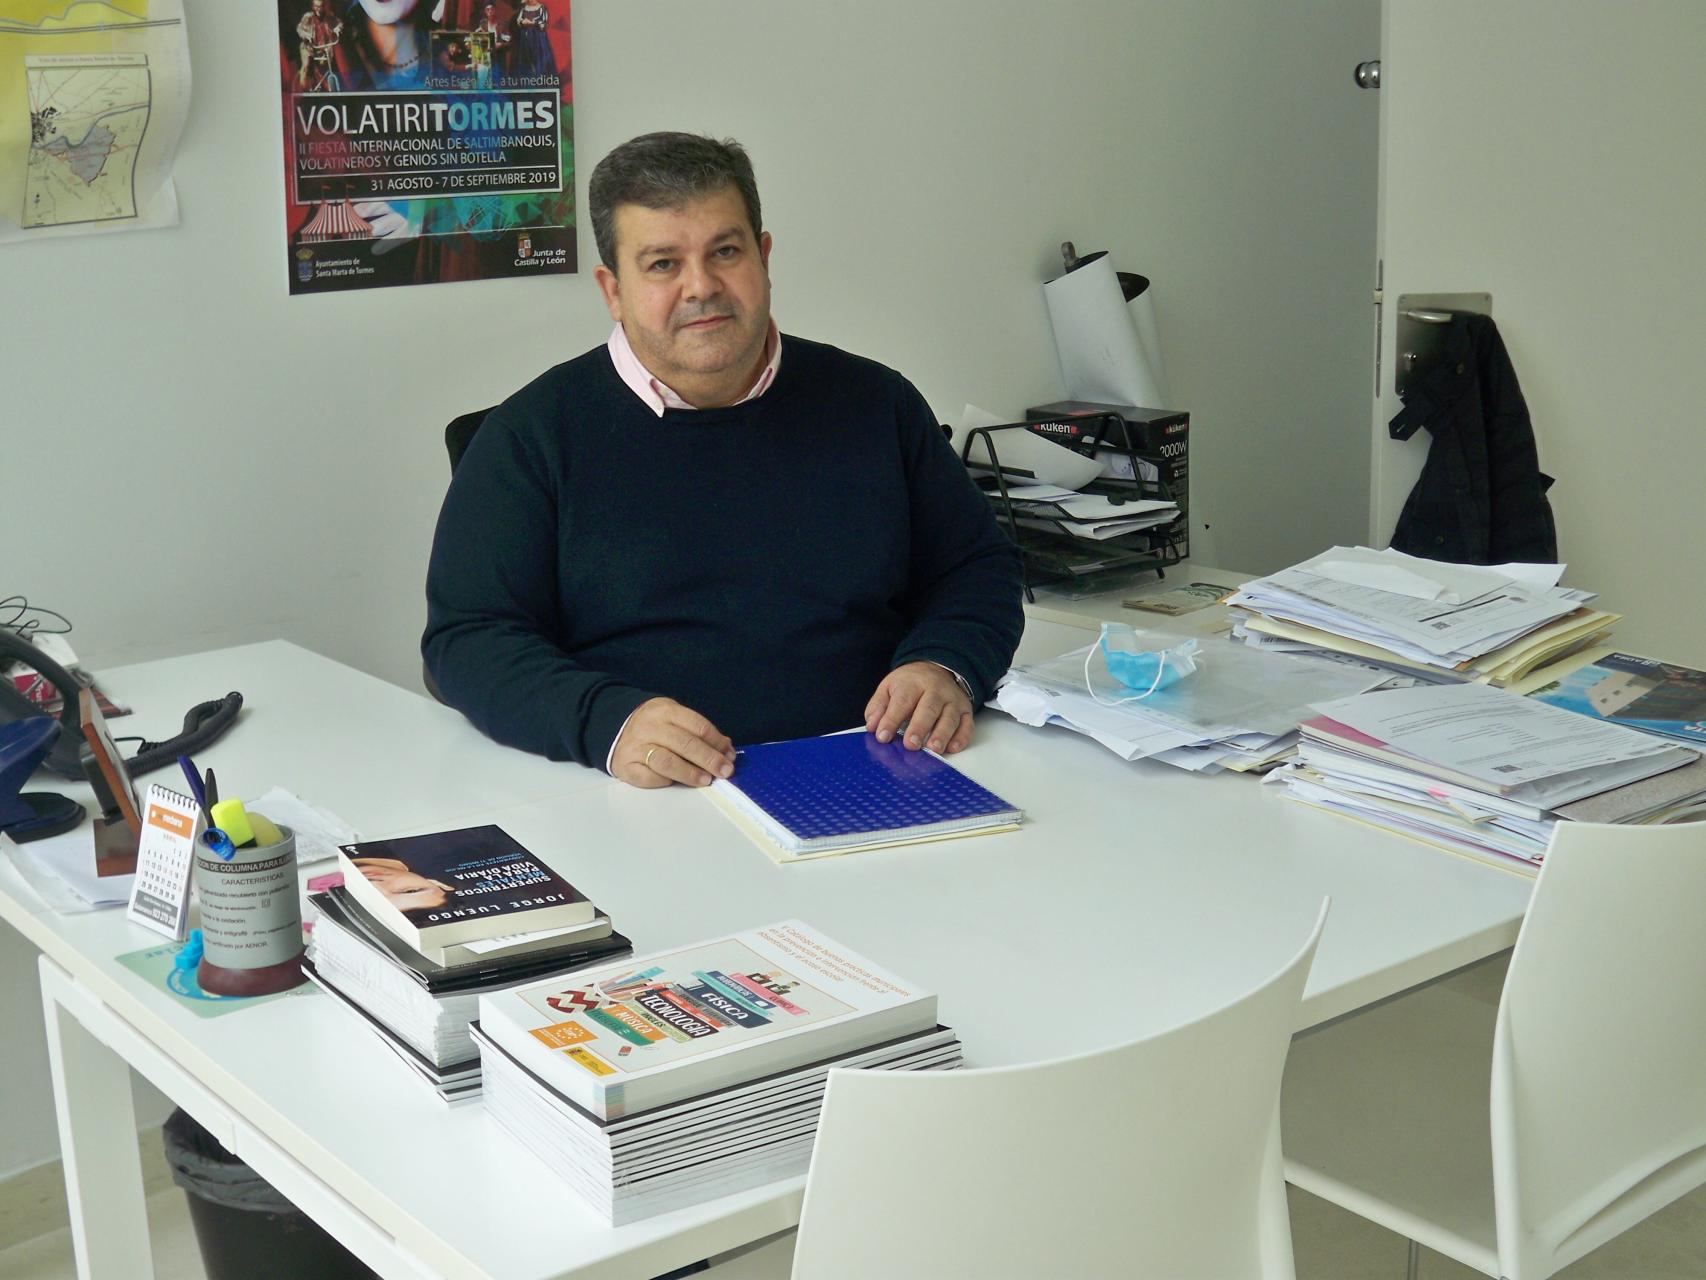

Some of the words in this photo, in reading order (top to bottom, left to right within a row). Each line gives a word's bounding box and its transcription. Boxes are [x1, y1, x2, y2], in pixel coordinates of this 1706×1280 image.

[424, 76, 449, 87] Artes
[507, 77, 518, 86] tu
[520, 74, 560, 86] medida
[297, 100, 554, 135] VOLATIRITORMES
[308, 141, 347, 154] FIESTA
[349, 137, 445, 153] INTERNACIONAL
[447, 137, 463, 149] DE
[464, 135, 556, 149] SALTIMBANQUIS,
[300, 155, 382, 171] VOLATINEROS
[383, 155, 391, 166] Y
[393, 152, 438, 167] GENIOS
[440, 152, 459, 165] SIN
[460, 151, 507, 164] BOTELLA
[371, 179, 383, 191] 31
[387, 177, 433, 190] AGOSTO
[442, 176, 448, 189] 7
[451, 176, 465, 188] DE
[466, 173, 526, 187] SEPTIEMBRE
[529, 171, 556, 184] 2019
[315, 259, 352, 269] Ayuntamiento
[514, 258, 539, 267] Castilla
[540, 259, 546, 267] y
[546, 256, 566, 265] León
[316, 269, 331, 278] Santa
[210, 863, 219, 872] DE
[220, 862, 258, 873] COLUMNA
[258, 860, 278, 871] PARA
[454, 867, 501, 880] DIARIA
[501, 861, 536, 871] VIDA
[506, 866, 540, 877] PARA
[476, 870, 545, 888] MENTALES
[484, 872, 501, 881] LA
[455, 875, 552, 897] SUPERTRUCOS
[509, 893, 566, 909] JORGE
[428, 904, 501, 922] LUENGO
[701, 993, 749, 1020] FÍSICA
[616, 1011, 654, 1034] MÚSICA
[641, 994, 711, 1038] TECNOLOGÍA
